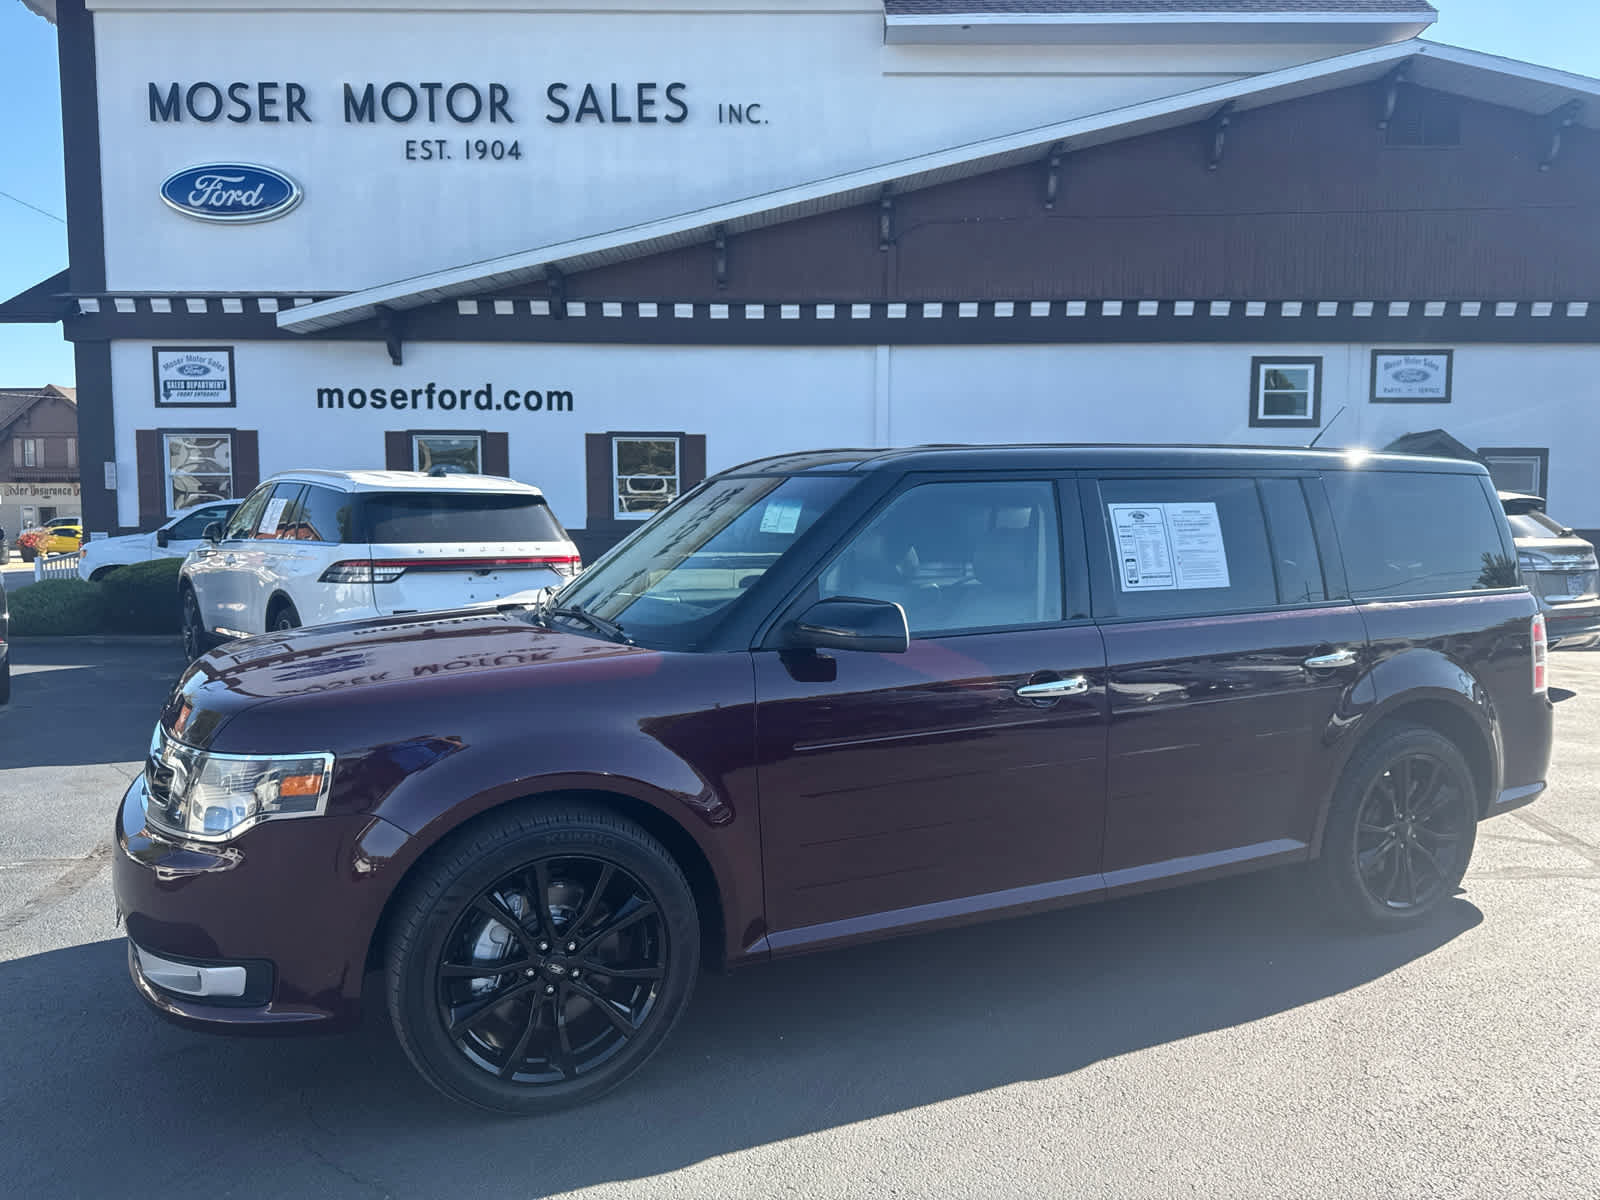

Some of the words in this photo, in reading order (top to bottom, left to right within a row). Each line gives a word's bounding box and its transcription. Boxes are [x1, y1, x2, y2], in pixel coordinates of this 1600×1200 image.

[148, 82, 312, 123] MOSER
[343, 82, 514, 124] MOTOR
[545, 82, 689, 124] SALES
[718, 103, 769, 125] INC.
[405, 140, 451, 161] EST.
[464, 140, 522, 161] 1904
[188, 174, 265, 206] Ford
[186, 354, 207, 363] Motor
[208, 358, 225, 372] Sales
[186, 380, 225, 390] DEPARTMENT
[316, 382, 574, 411] moserford.com
